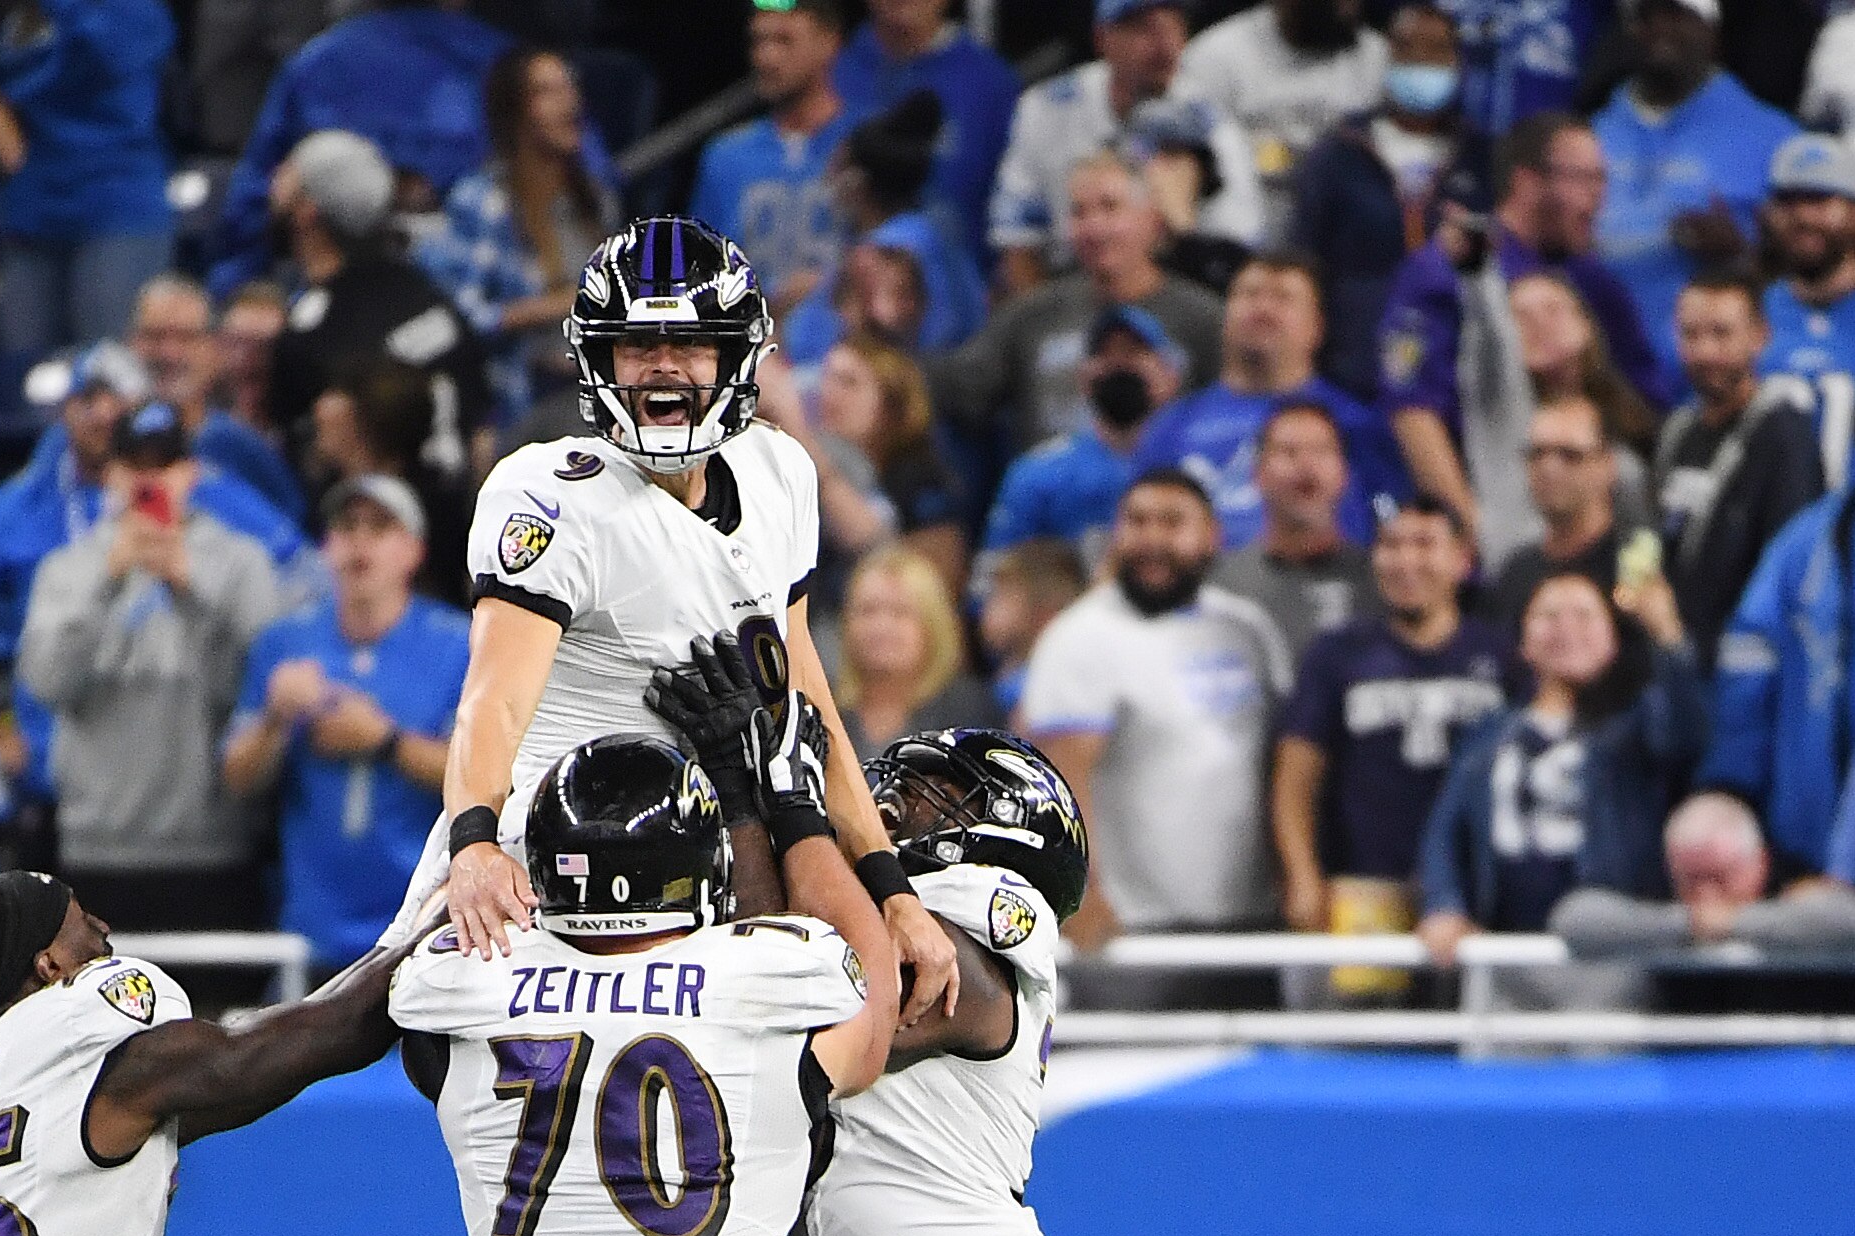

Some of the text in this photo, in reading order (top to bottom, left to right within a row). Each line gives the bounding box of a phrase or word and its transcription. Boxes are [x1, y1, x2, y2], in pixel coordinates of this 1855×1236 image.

[553, 451, 605, 481] 9
[563, 918, 648, 931] RAVENS
[508, 961, 706, 1019] ZEITLER
